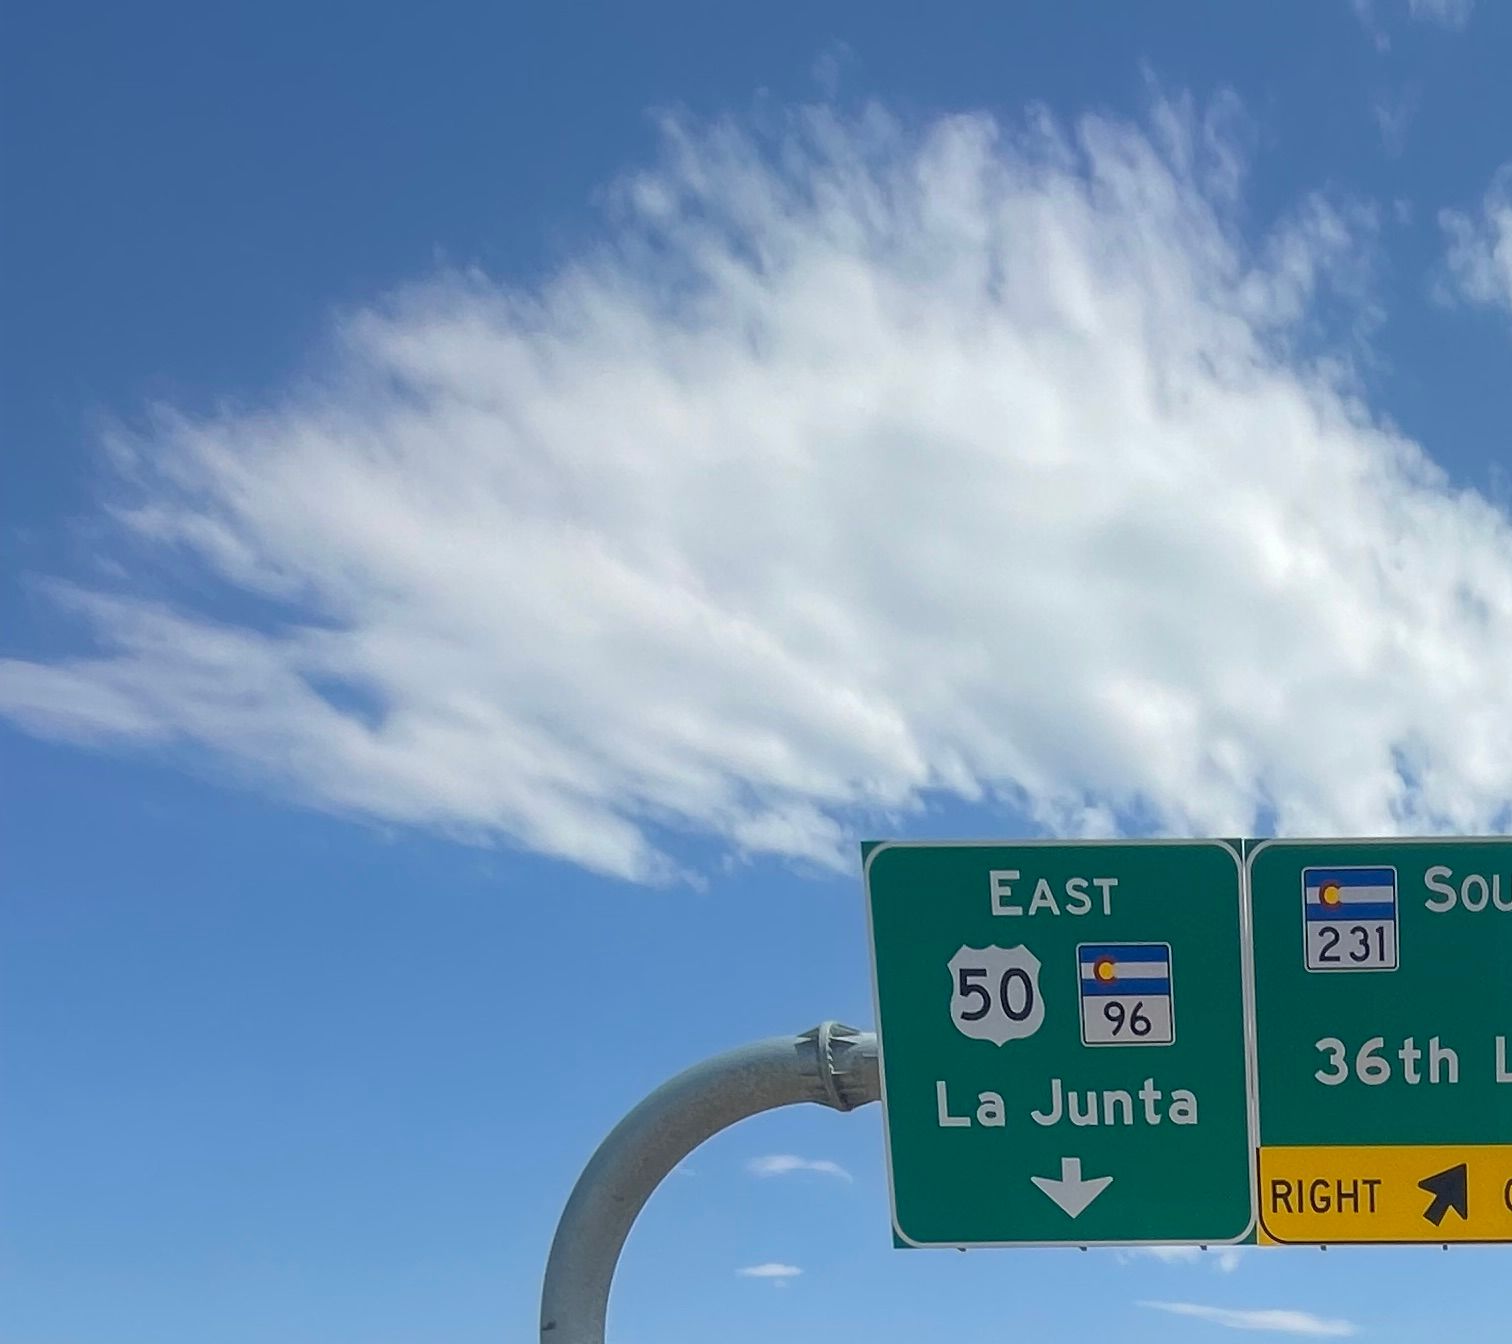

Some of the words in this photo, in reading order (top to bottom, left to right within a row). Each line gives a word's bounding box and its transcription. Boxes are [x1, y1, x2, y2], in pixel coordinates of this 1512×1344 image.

[989, 869, 1118, 917] EAST
[1318, 925, 1387, 963] 231
[958, 967, 1034, 1021] 50
[1102, 1001, 1153, 1037] 96
[1314, 1036, 1460, 1085] 36th
[936, 1080, 1006, 1127] La
[1030, 1078, 1198, 1127] Junta
[1271, 1178, 1383, 1214] RIGHT
